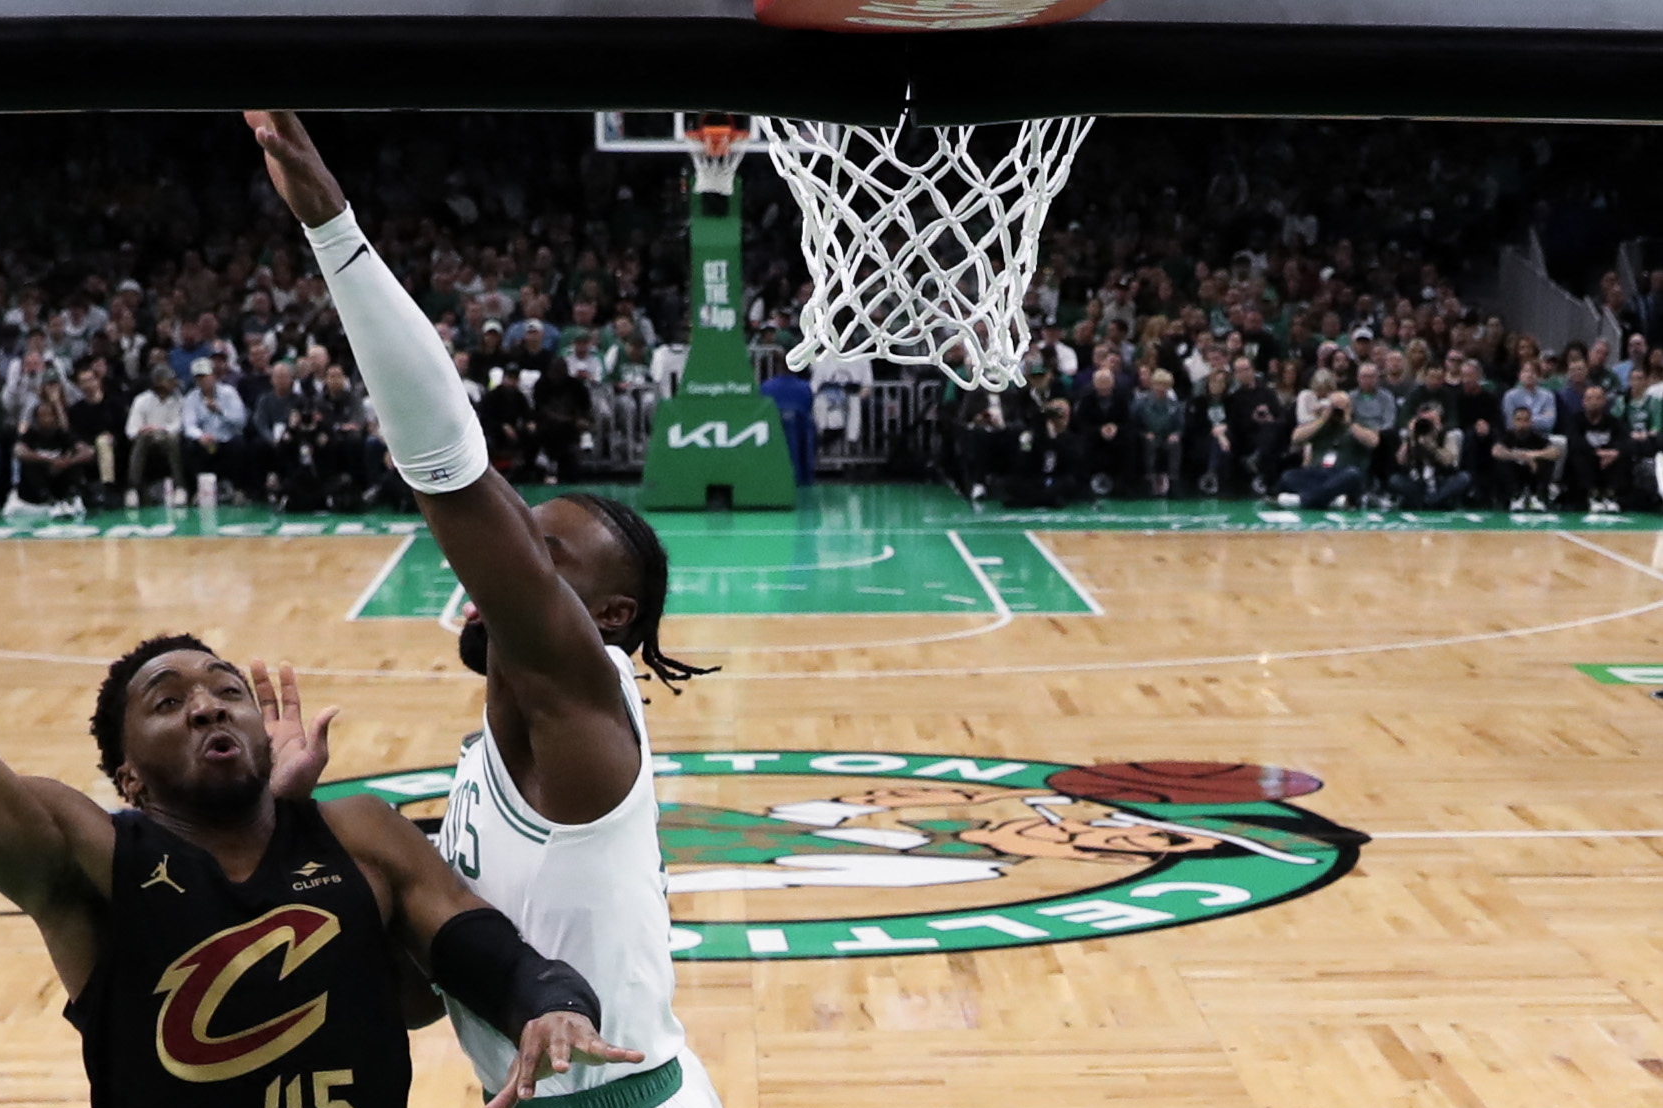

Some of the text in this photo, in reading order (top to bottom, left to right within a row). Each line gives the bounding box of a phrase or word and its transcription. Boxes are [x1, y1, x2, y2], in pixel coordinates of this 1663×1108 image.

[668, 420, 769, 448] KIA
[365, 753, 1027, 797] BTON
[292, 874, 342, 891] CLIFFS
[669, 881, 1251, 952] CELTI
[152, 903, 341, 1083] C
